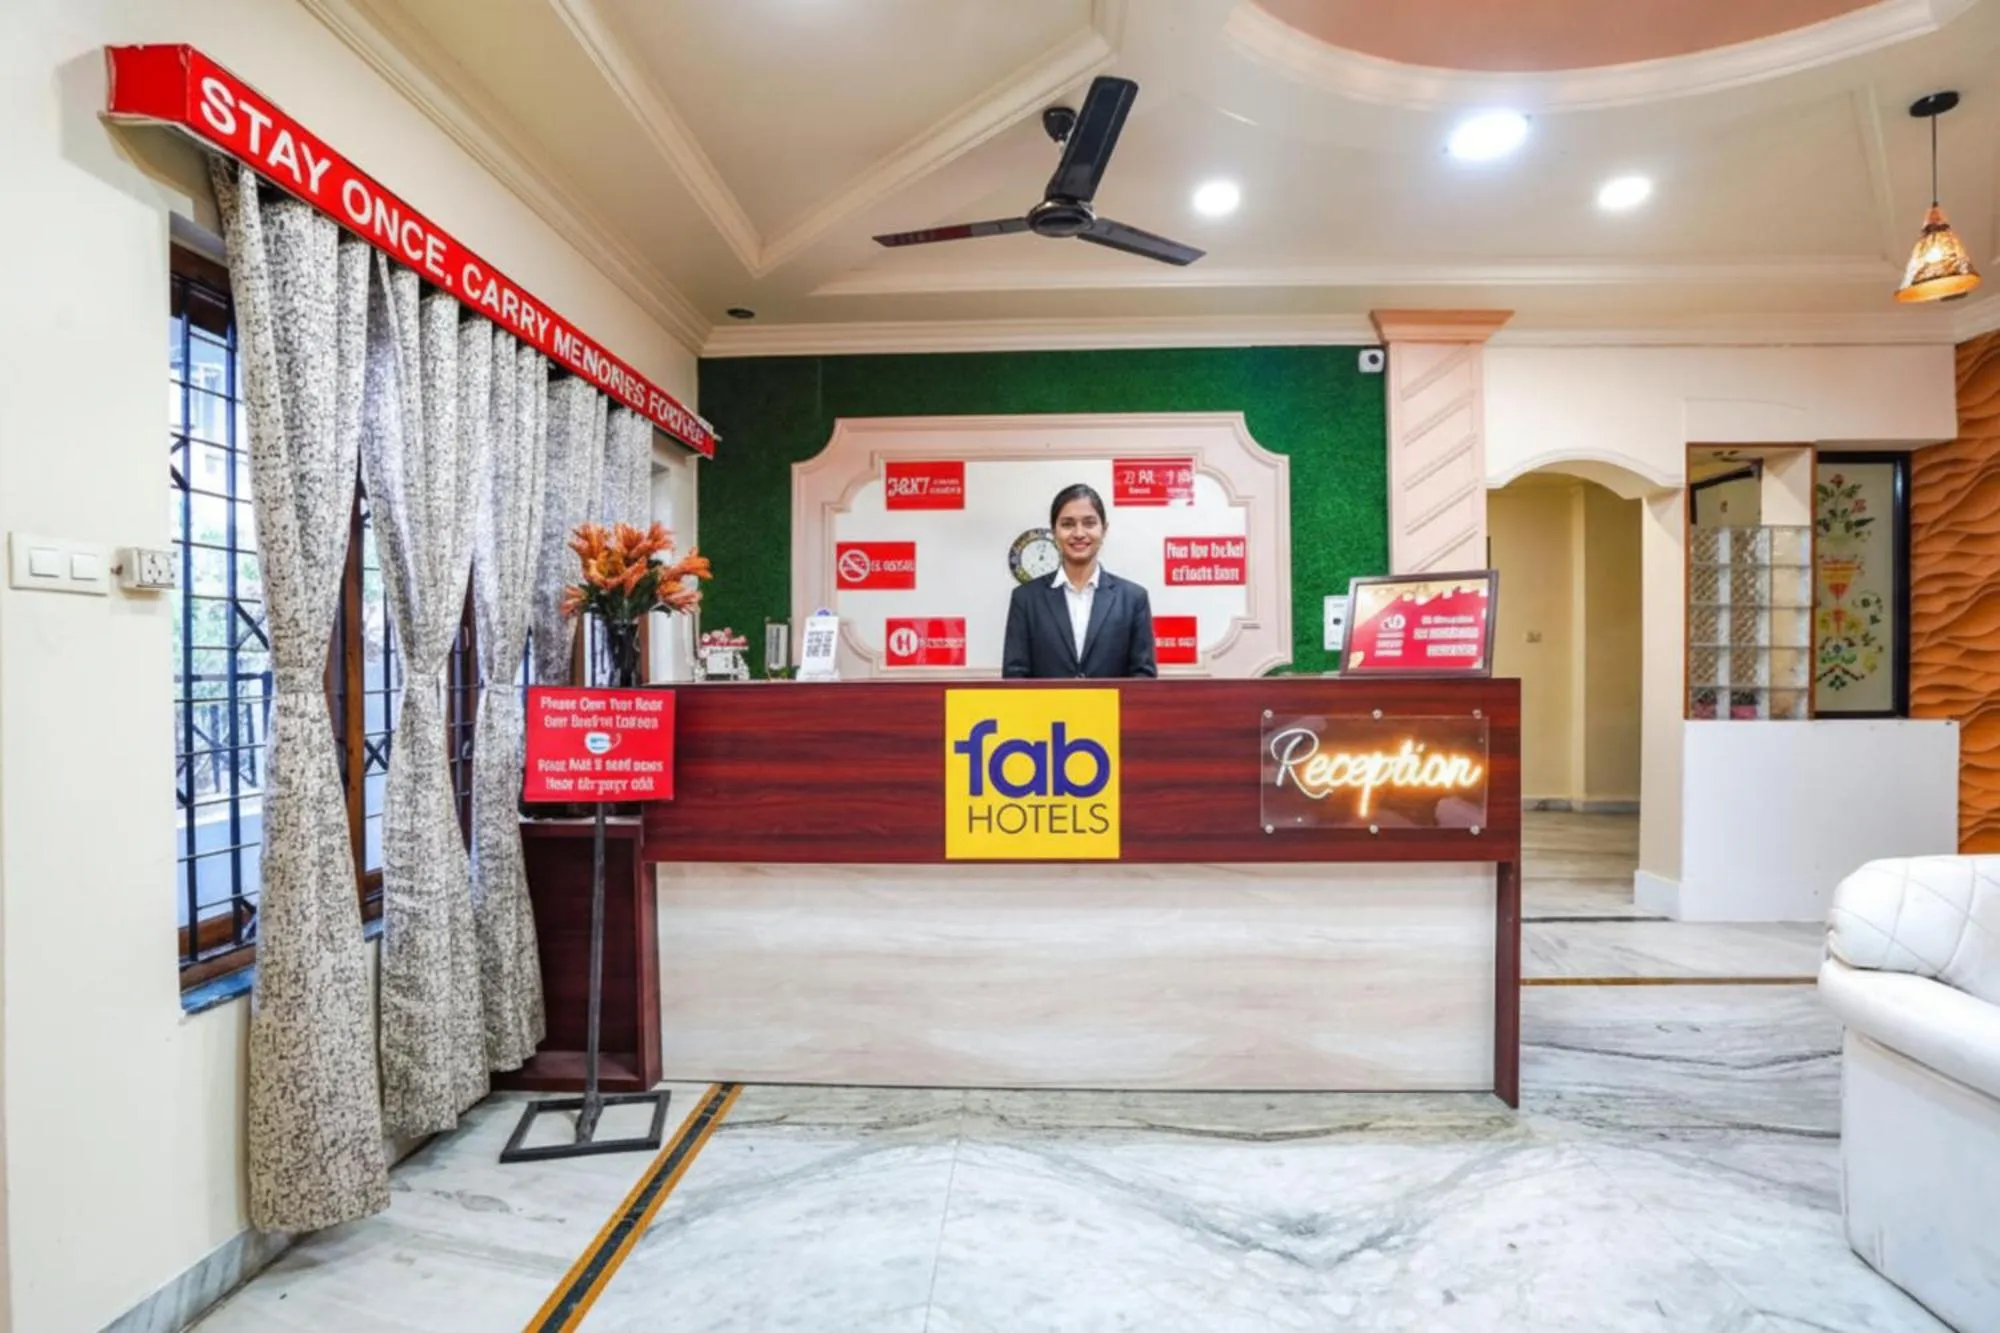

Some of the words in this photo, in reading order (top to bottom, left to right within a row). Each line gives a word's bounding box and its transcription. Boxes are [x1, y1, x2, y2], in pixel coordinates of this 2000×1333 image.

[200, 76, 332, 195] STAY
[462, 263, 550, 344] CARRY
[954, 719, 1110, 798] fab
[1270, 728, 1483, 818] Reception
[968, 803, 1110, 834] HOTELS
